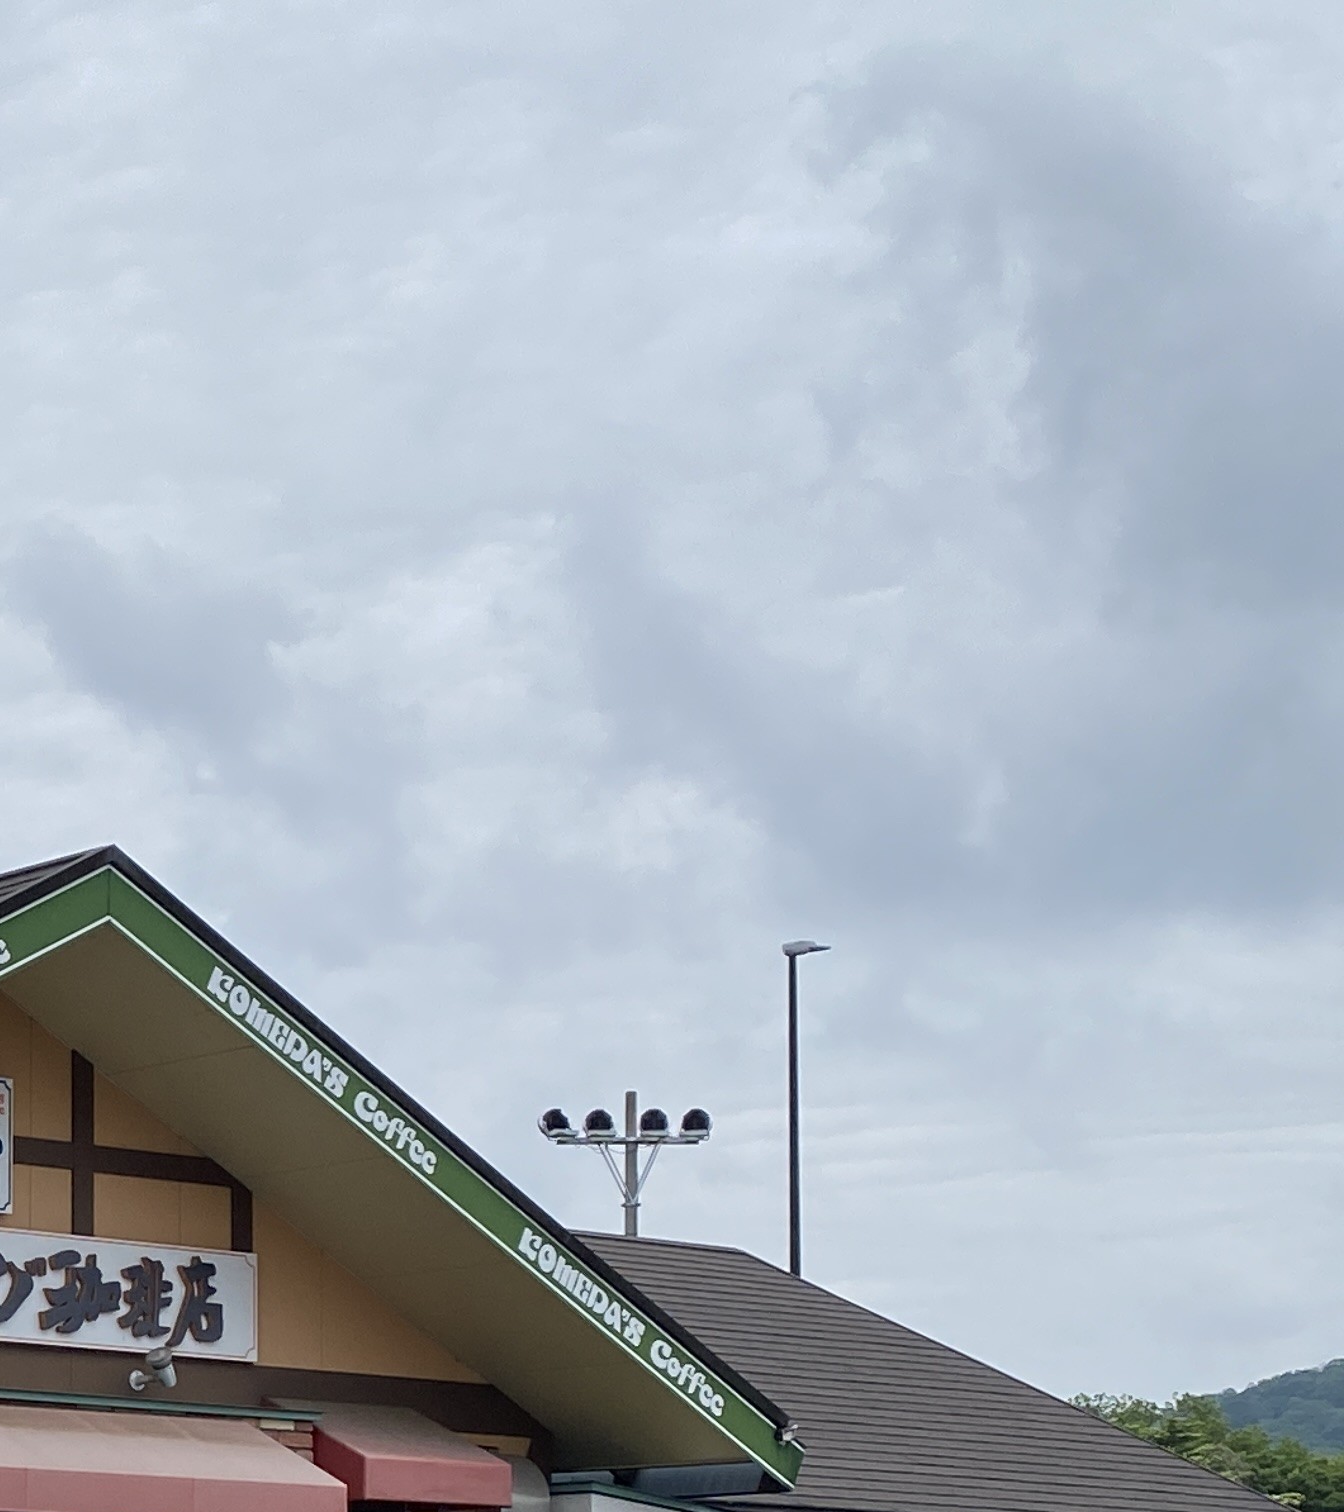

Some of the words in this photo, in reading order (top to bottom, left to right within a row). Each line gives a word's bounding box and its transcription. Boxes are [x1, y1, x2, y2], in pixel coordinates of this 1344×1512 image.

[206, 965, 349, 1099] KOMEDA'S
[354, 1091, 438, 1176] Coffee
[517, 1226, 646, 1347] KOMEDA'S
[649, 1339, 725, 1417] Coffee
